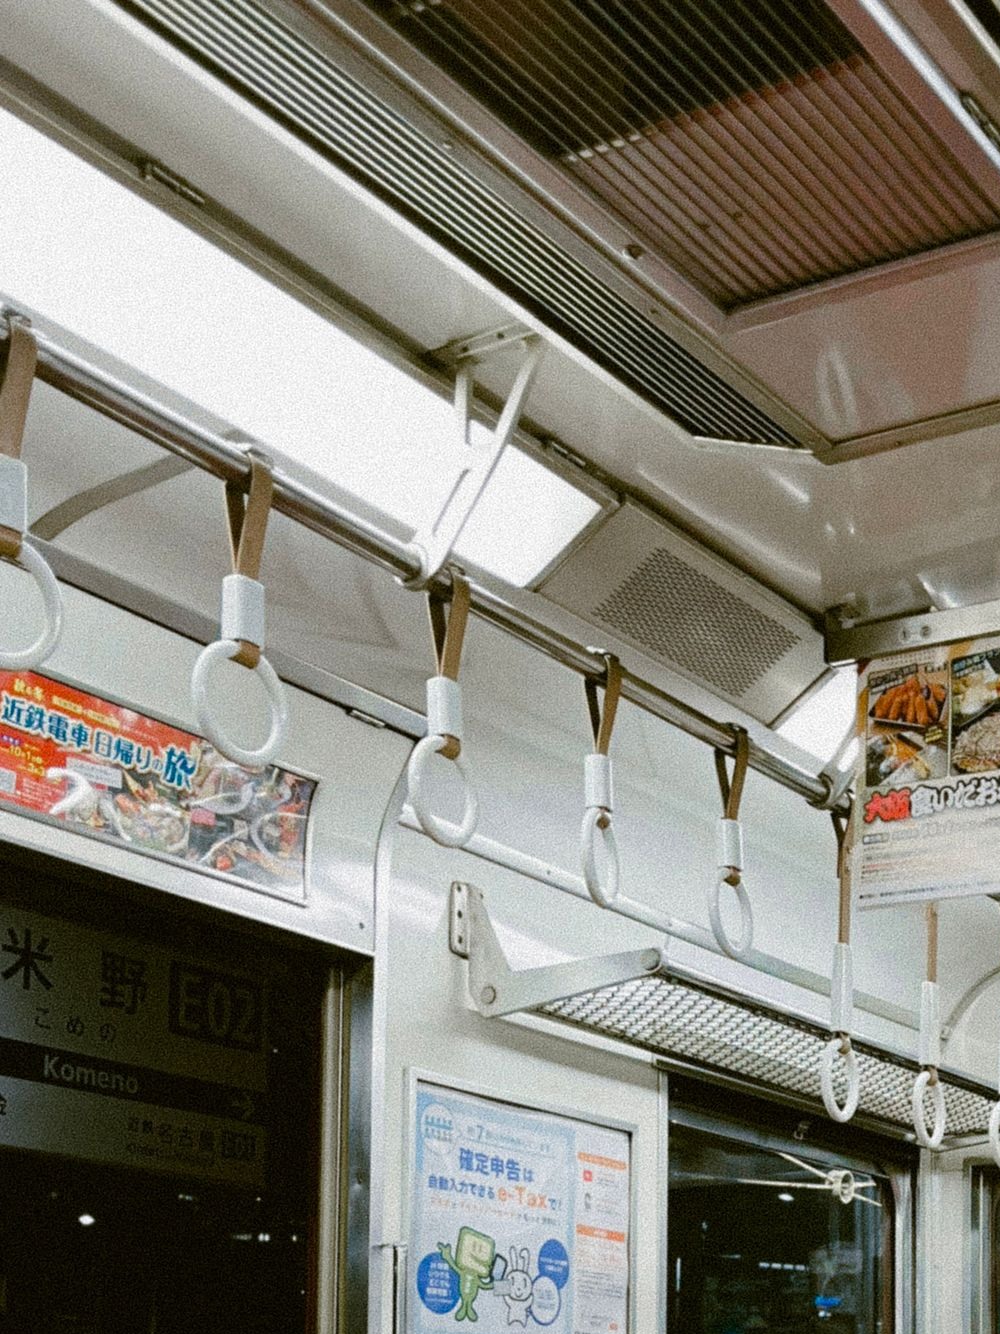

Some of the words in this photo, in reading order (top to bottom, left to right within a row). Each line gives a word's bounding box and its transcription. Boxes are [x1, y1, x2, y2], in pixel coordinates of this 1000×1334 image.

[2, 927, 148, 1015] 米野
[43, 1054, 140, 1095] Komeno
[459, 1147, 535, 1183] 確定申告は
